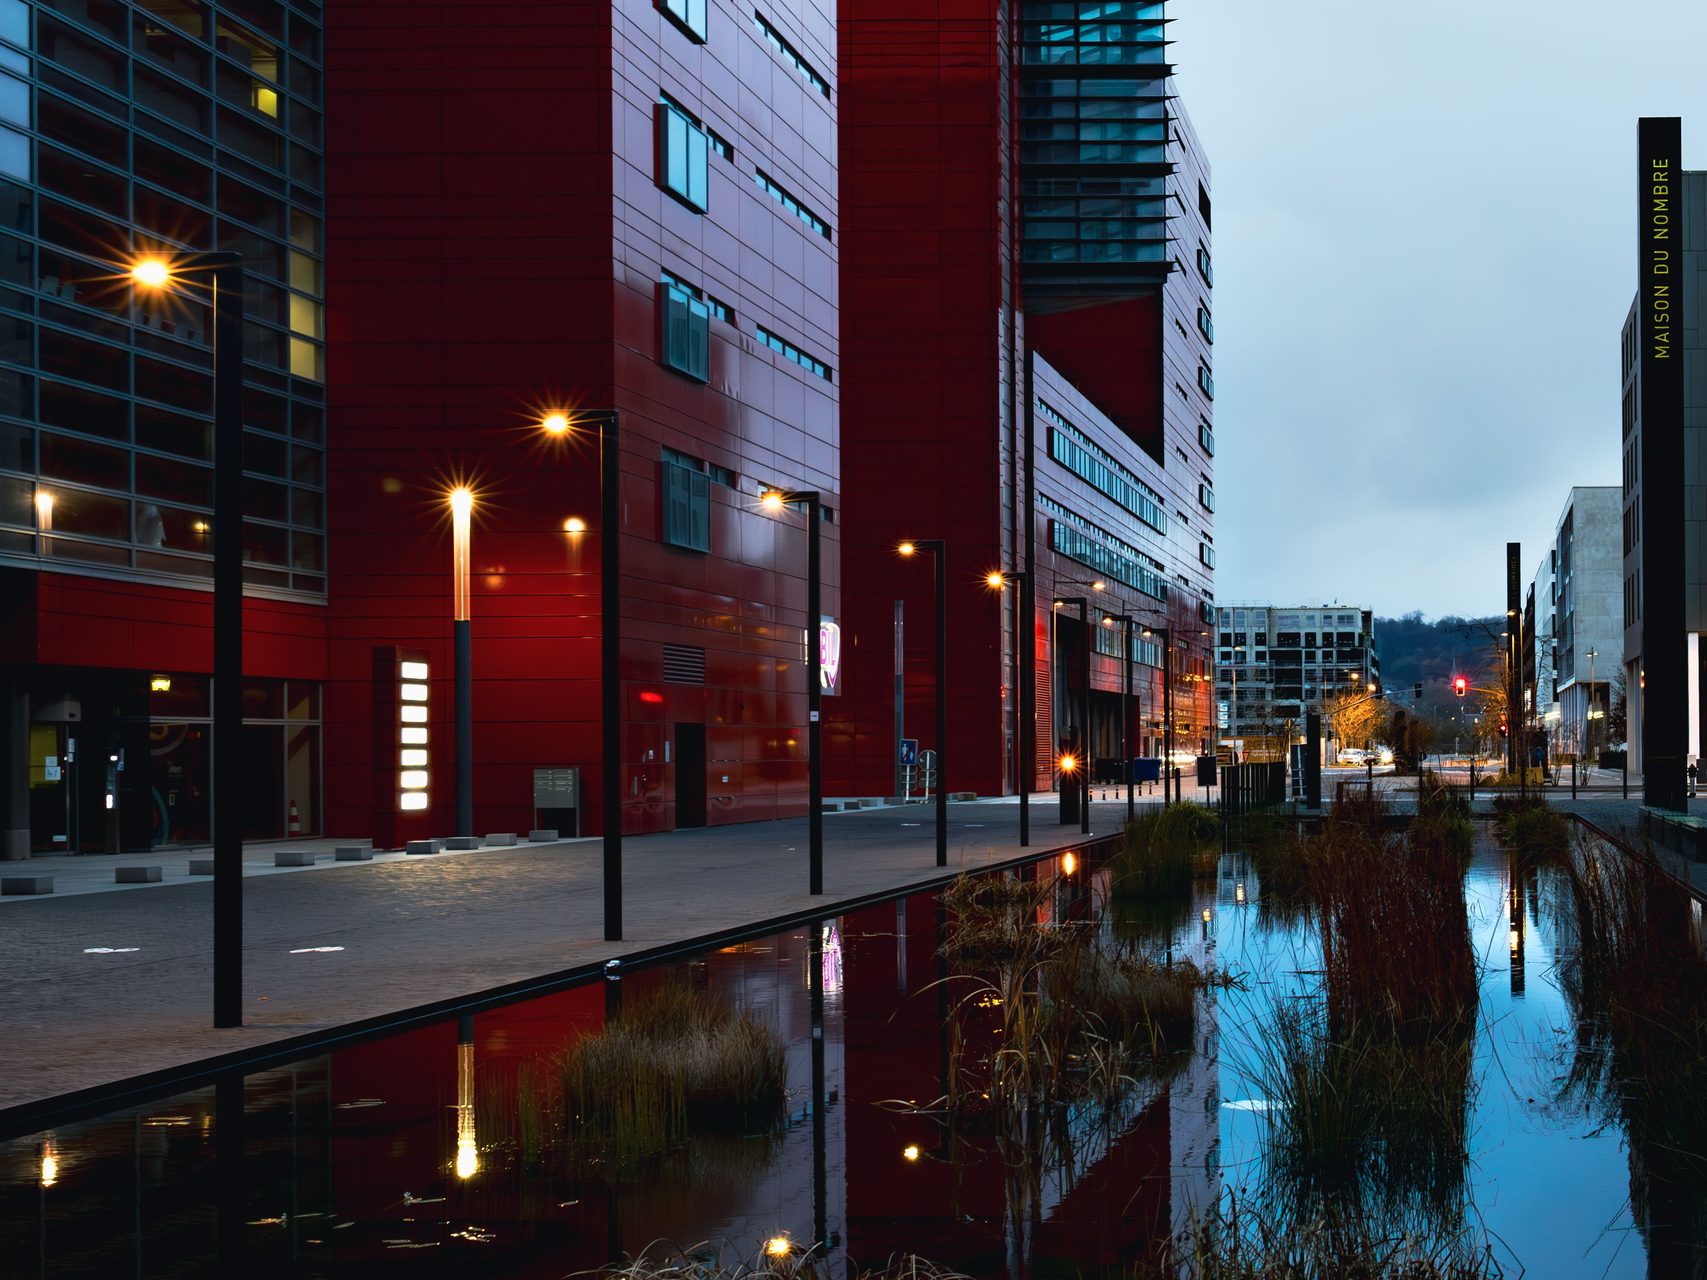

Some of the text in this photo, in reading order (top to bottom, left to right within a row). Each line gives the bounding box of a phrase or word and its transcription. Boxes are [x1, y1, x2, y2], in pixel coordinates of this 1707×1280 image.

[1652, 158, 1670, 359] MAISON DU NOMBRE
